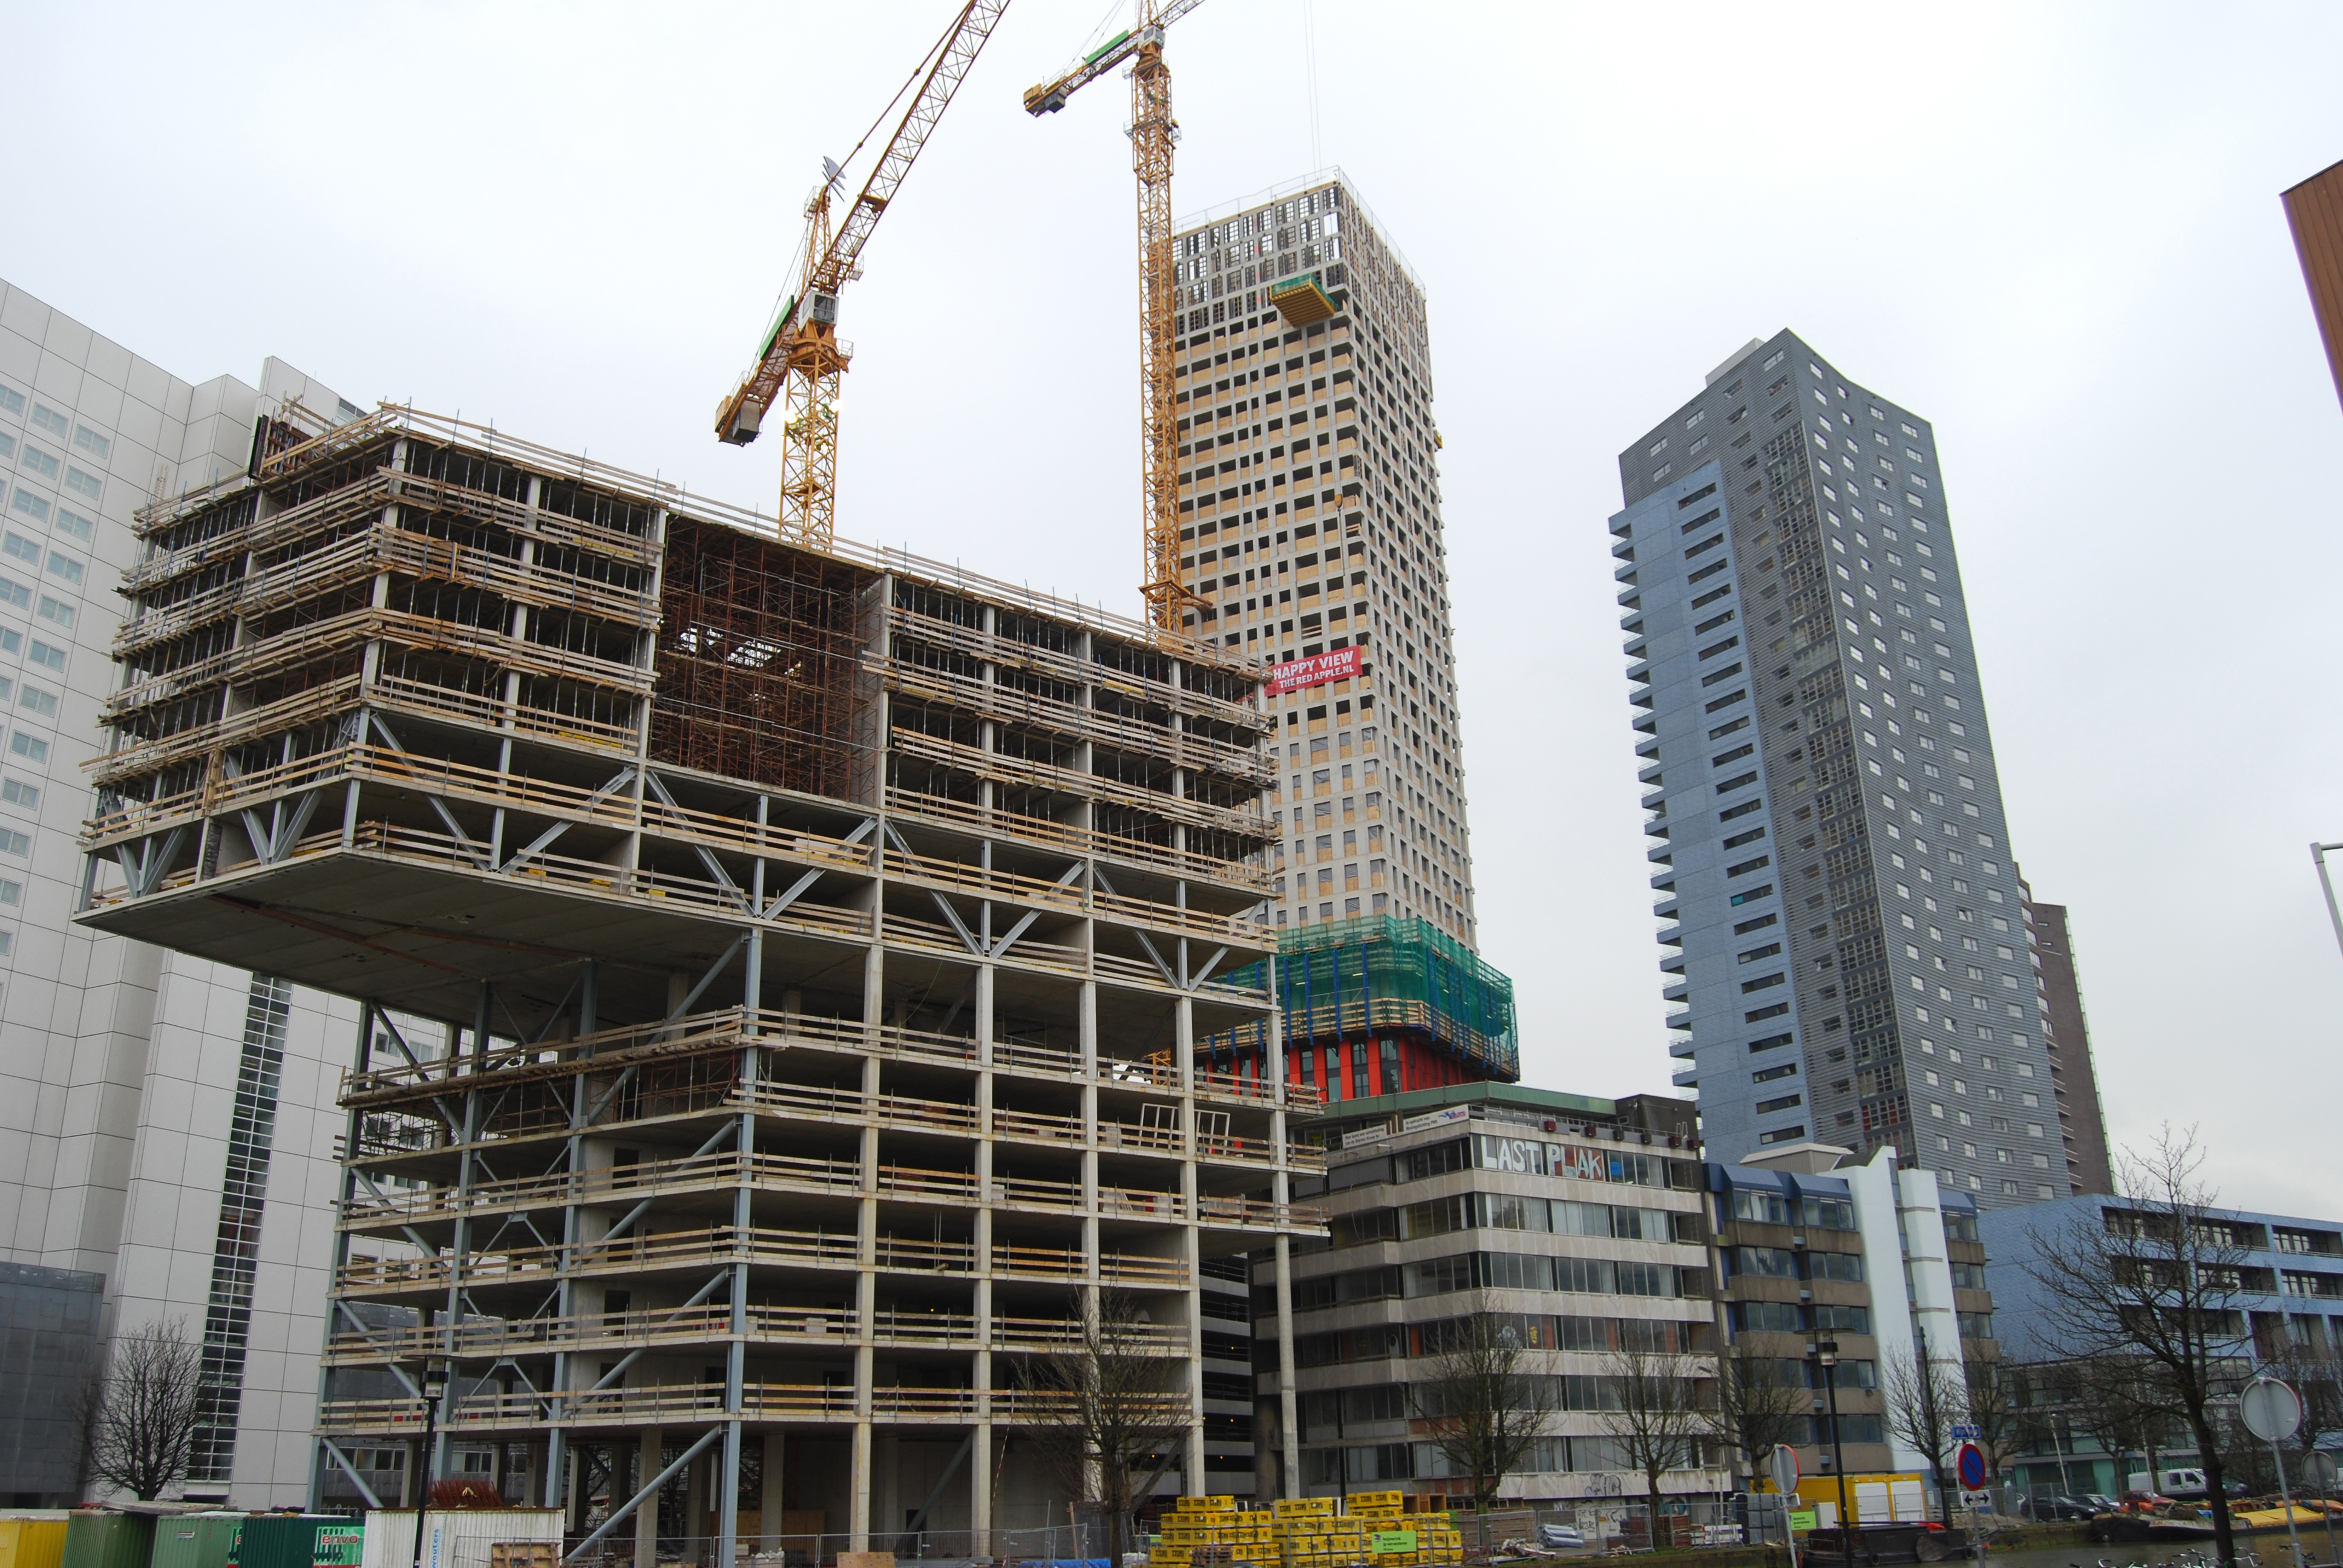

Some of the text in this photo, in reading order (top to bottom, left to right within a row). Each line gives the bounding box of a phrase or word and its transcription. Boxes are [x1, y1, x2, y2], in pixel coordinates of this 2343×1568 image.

[1273, 650, 1354, 680] HAPPY VIEW
[1279, 664, 1354, 688] THE RED APPLE.NL
[1481, 1135, 1603, 1180] LAST PLAK
